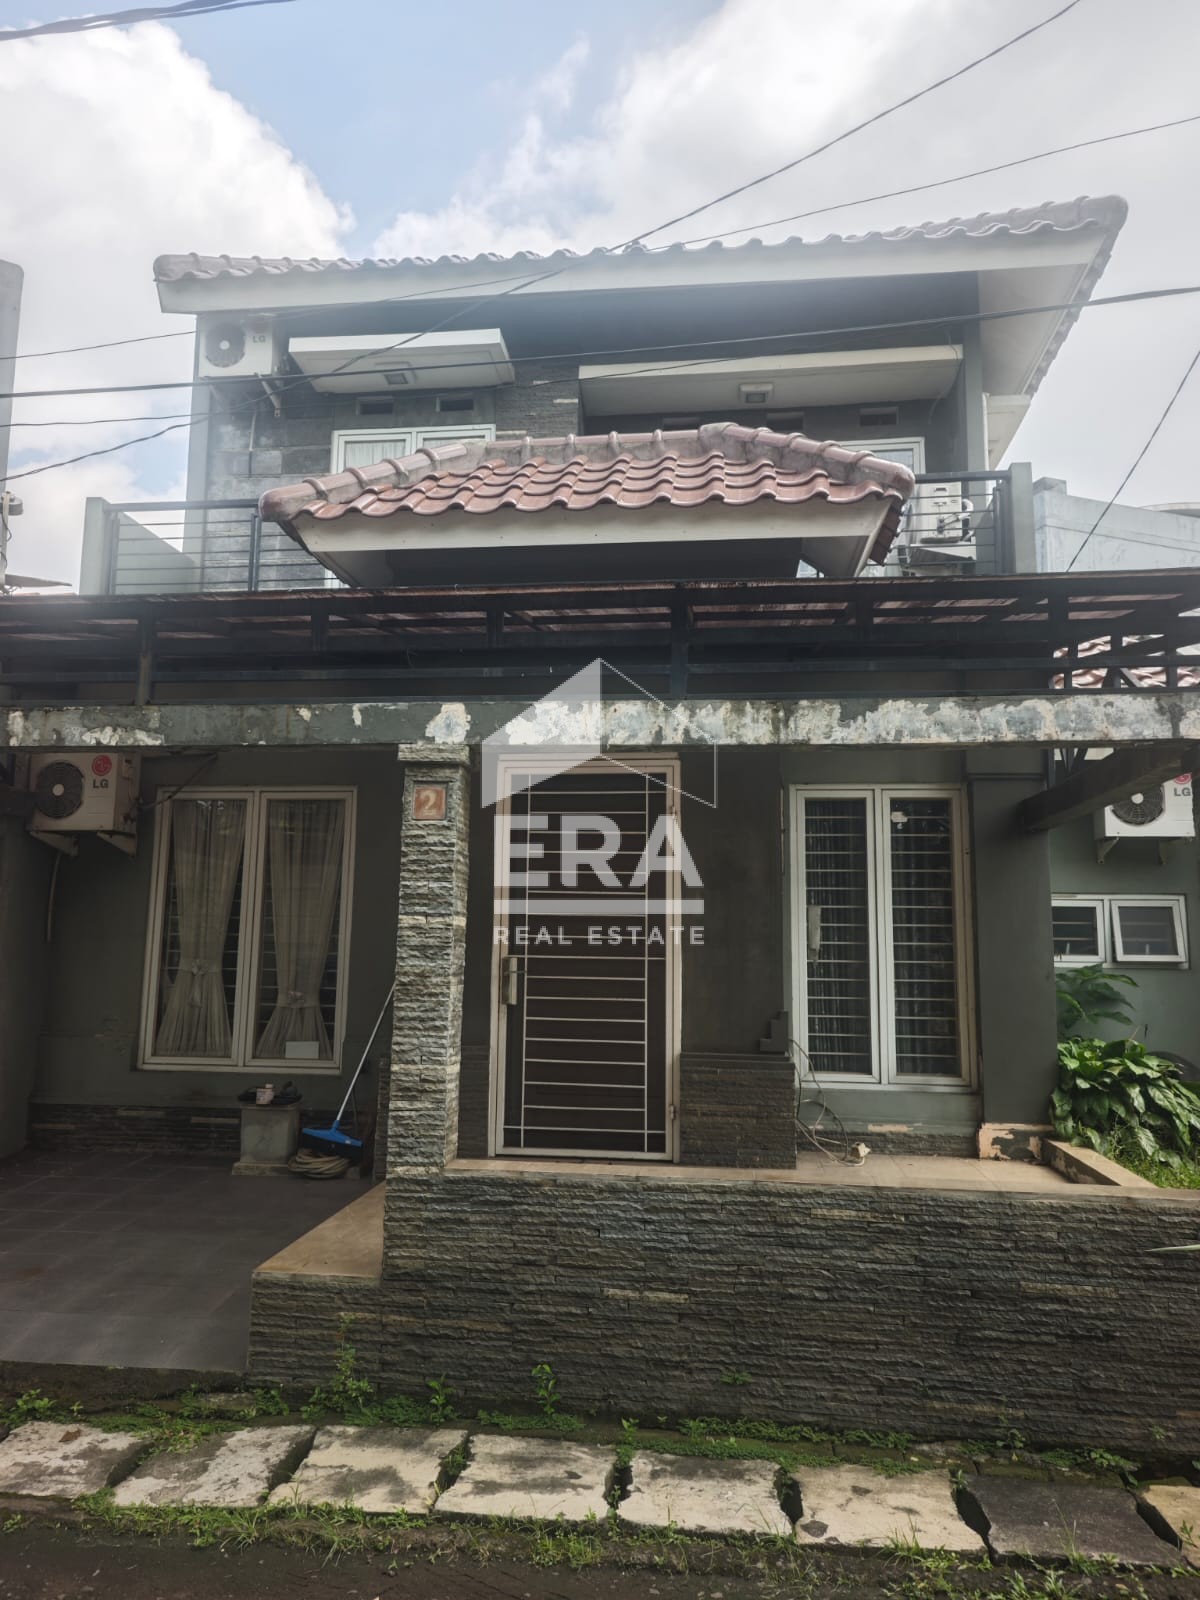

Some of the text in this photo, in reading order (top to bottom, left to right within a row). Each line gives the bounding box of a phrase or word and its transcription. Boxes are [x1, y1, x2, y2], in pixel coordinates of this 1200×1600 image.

[252, 335, 266, 343] LG
[93, 779, 109, 789] LG
[1174, 787, 1191, 797] LG
[420, 789, 438, 816] 2
